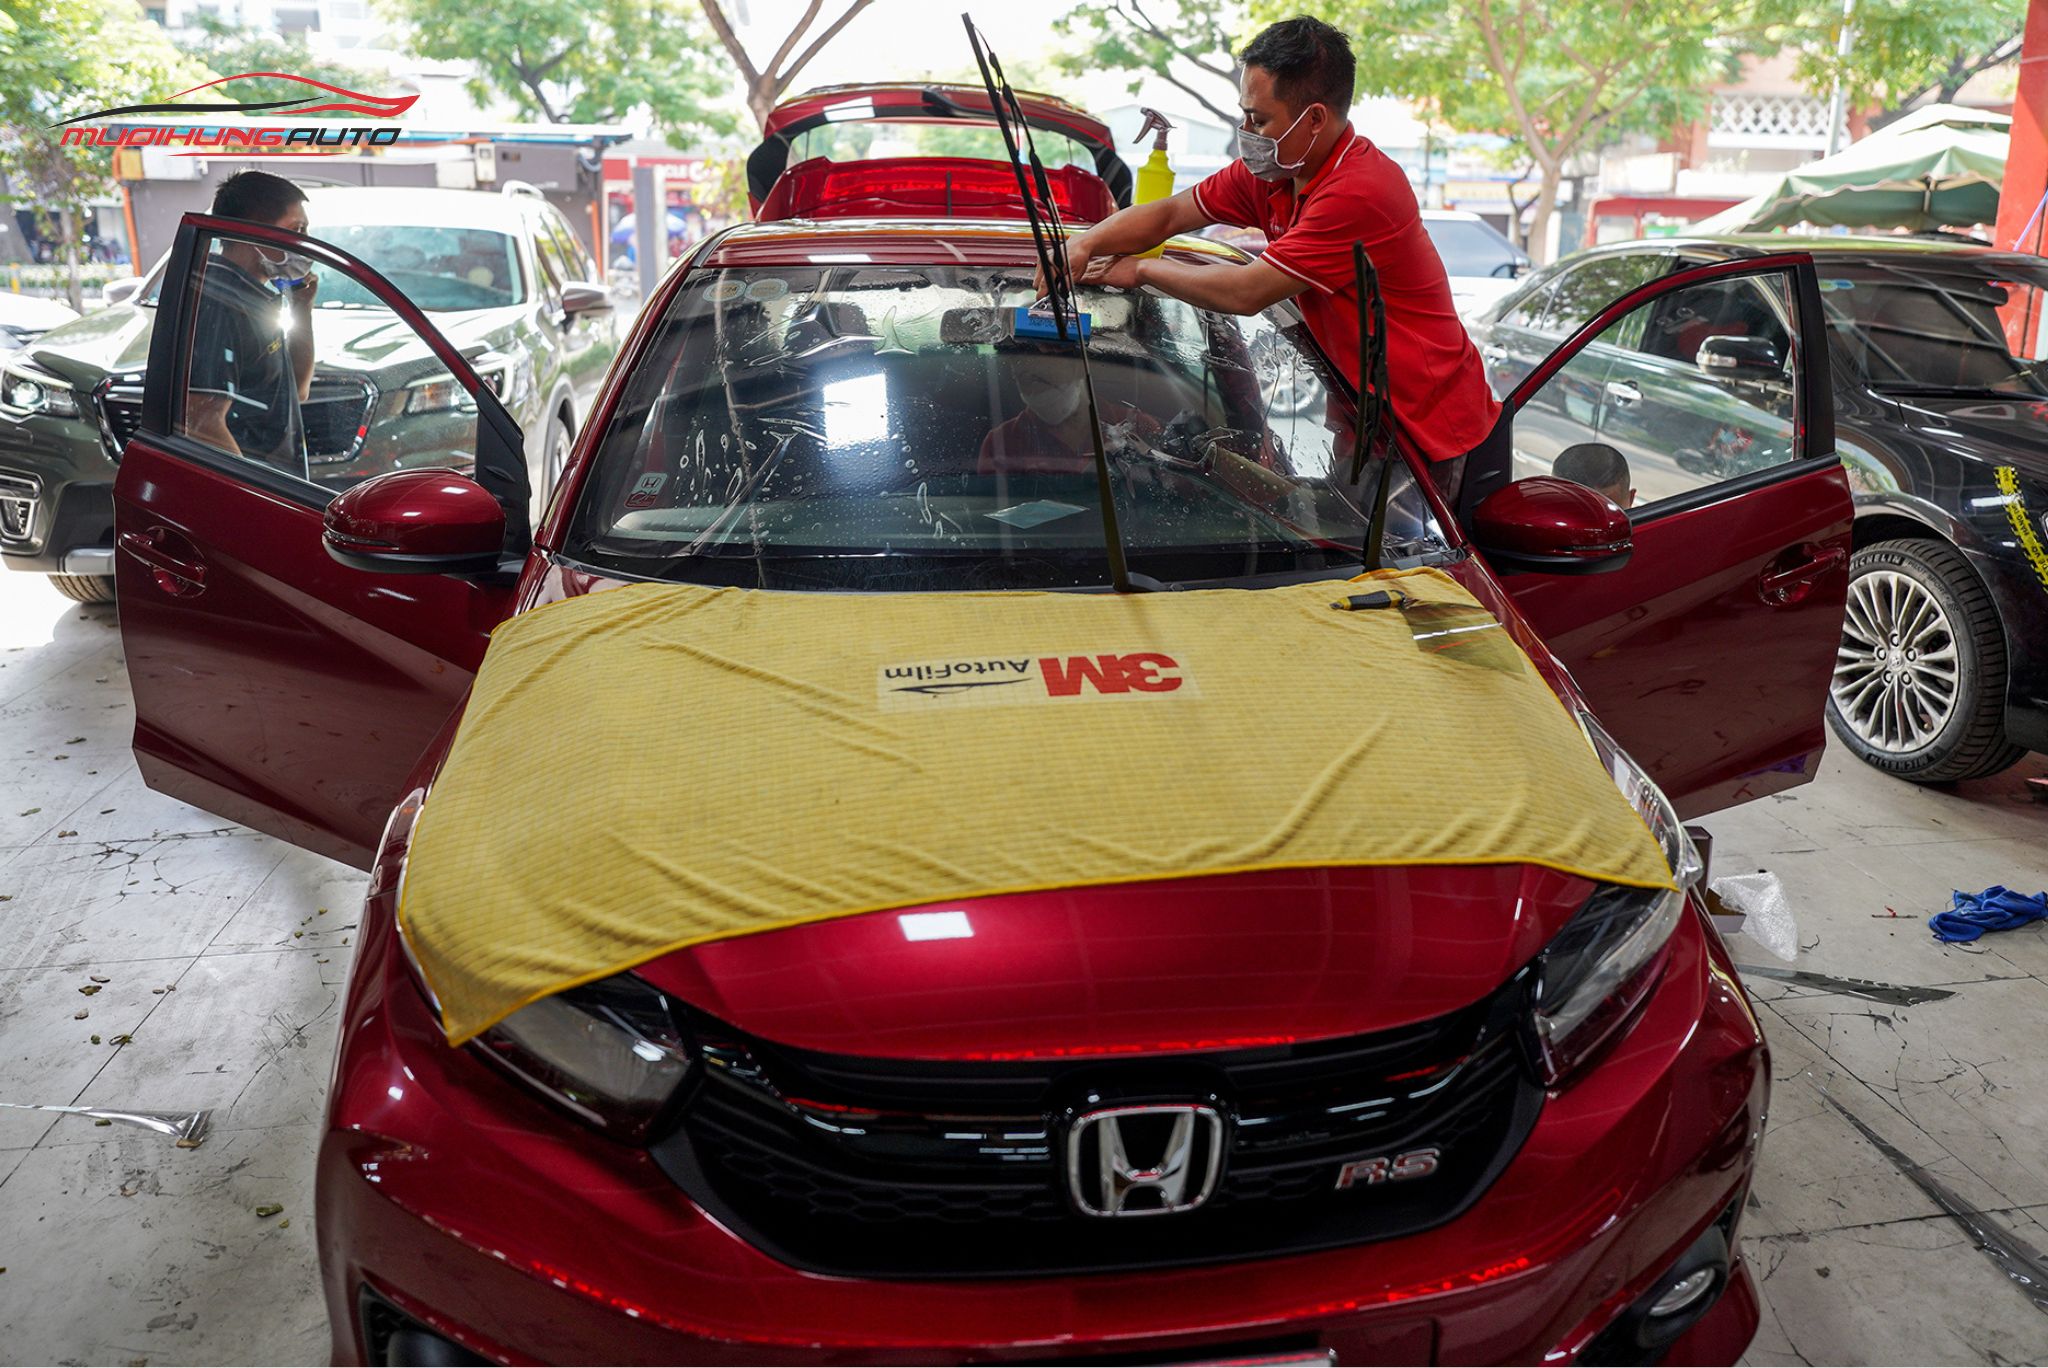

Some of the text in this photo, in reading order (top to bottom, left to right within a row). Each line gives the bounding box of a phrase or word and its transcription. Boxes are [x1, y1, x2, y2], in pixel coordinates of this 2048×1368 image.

[1850, 553, 1901, 571] MICHELIN
[884, 652, 1182, 697] 3M AutoFilm
[1867, 753, 1930, 769] MICHELIN
[1335, 1148, 1441, 1190] RS
